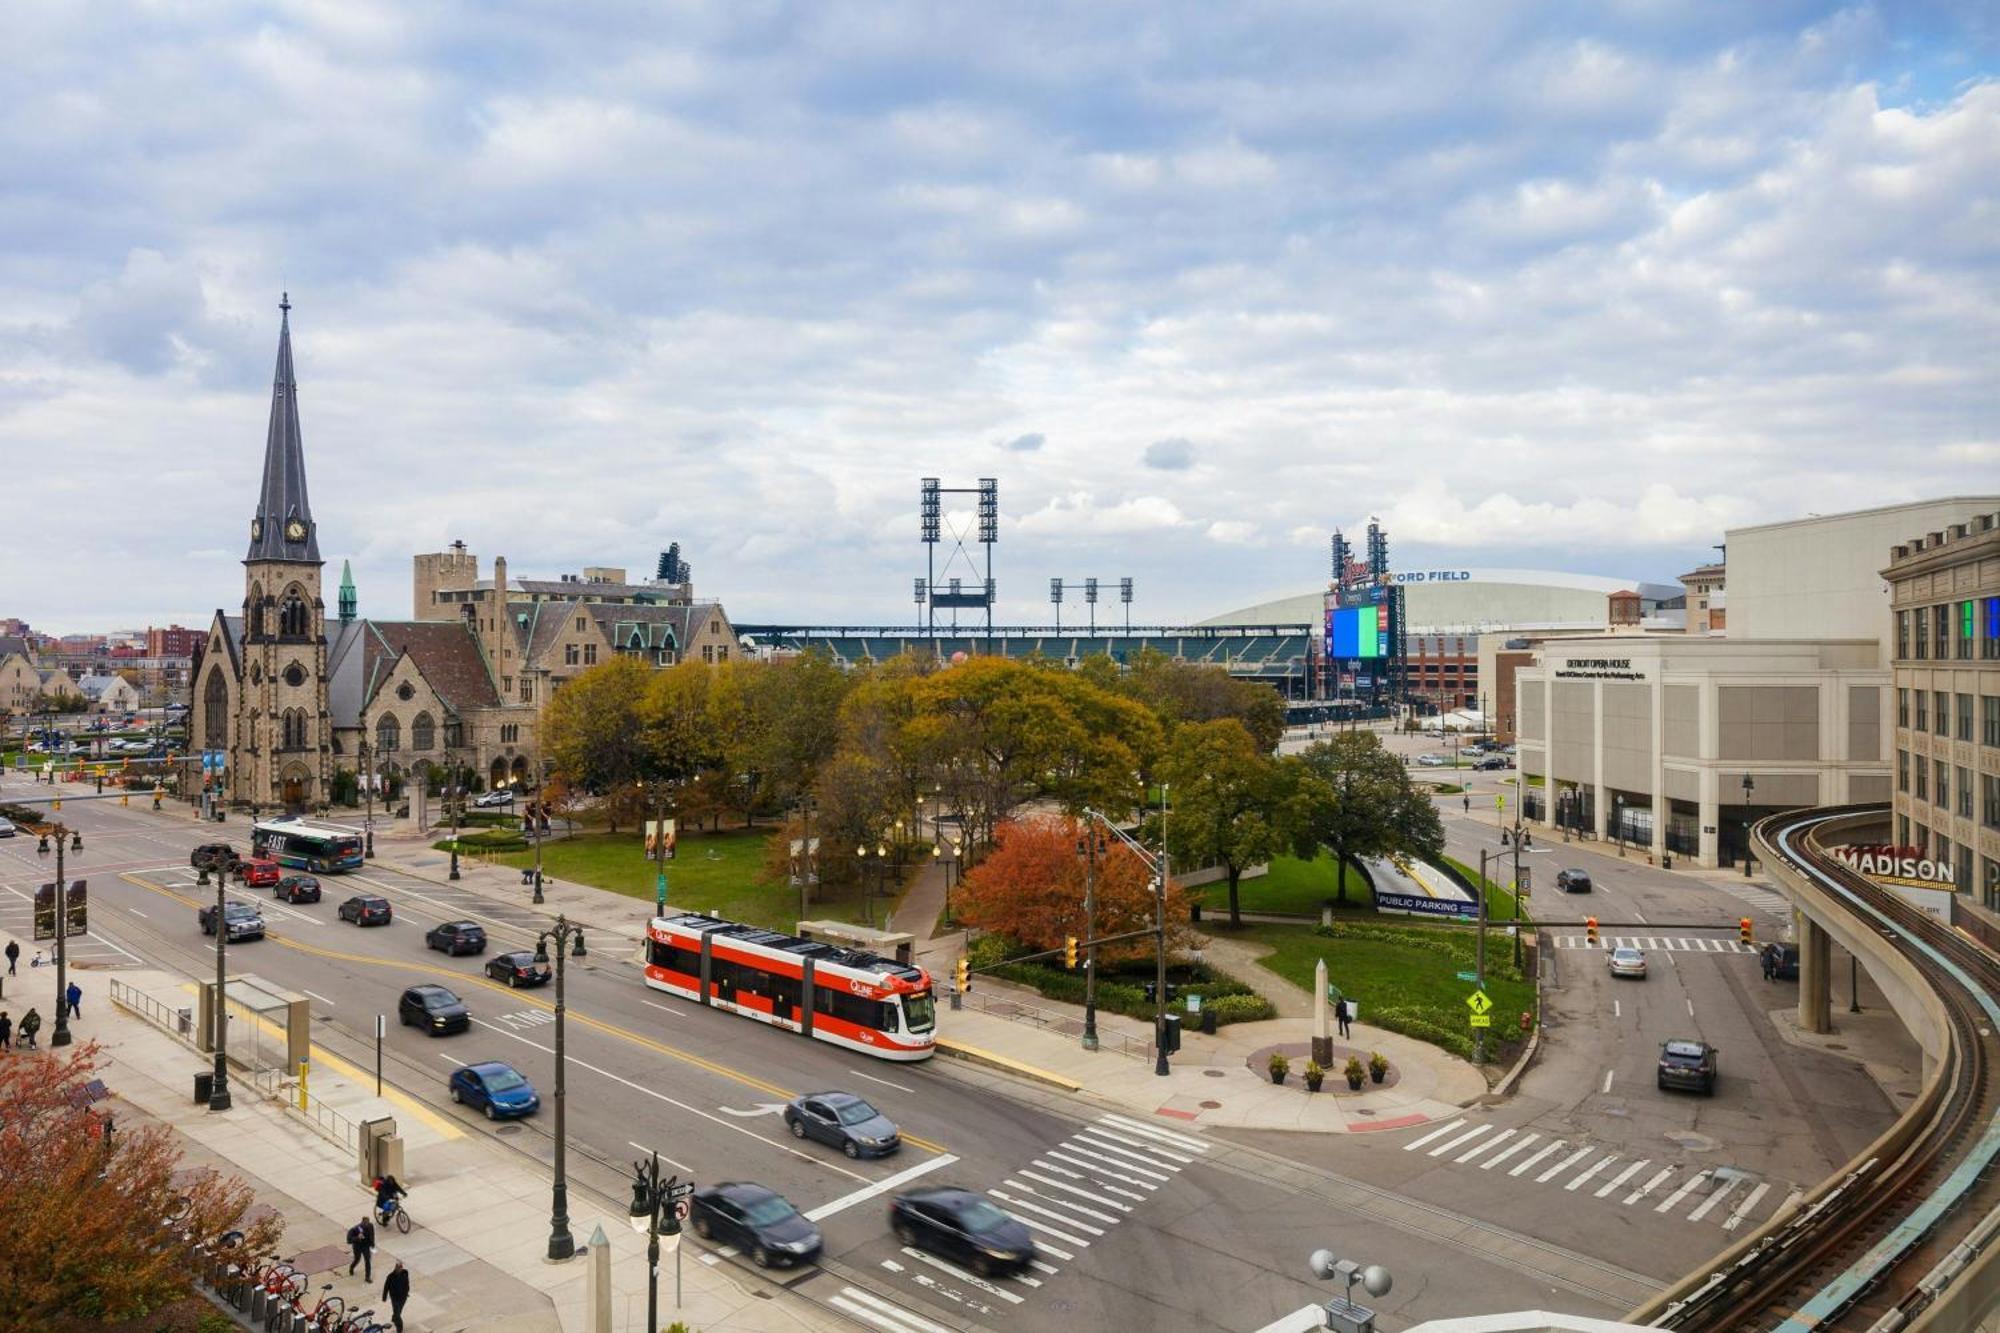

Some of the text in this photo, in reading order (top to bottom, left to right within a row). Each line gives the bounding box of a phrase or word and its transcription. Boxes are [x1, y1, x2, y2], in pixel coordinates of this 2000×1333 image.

[1393, 571, 1470, 582] ORD FIELD
[268, 834, 287, 850] FAST
[1838, 850, 1954, 882] MADISON
[1379, 895, 1413, 907] PUBLIC
[1415, 900, 1458, 912] PARKING
